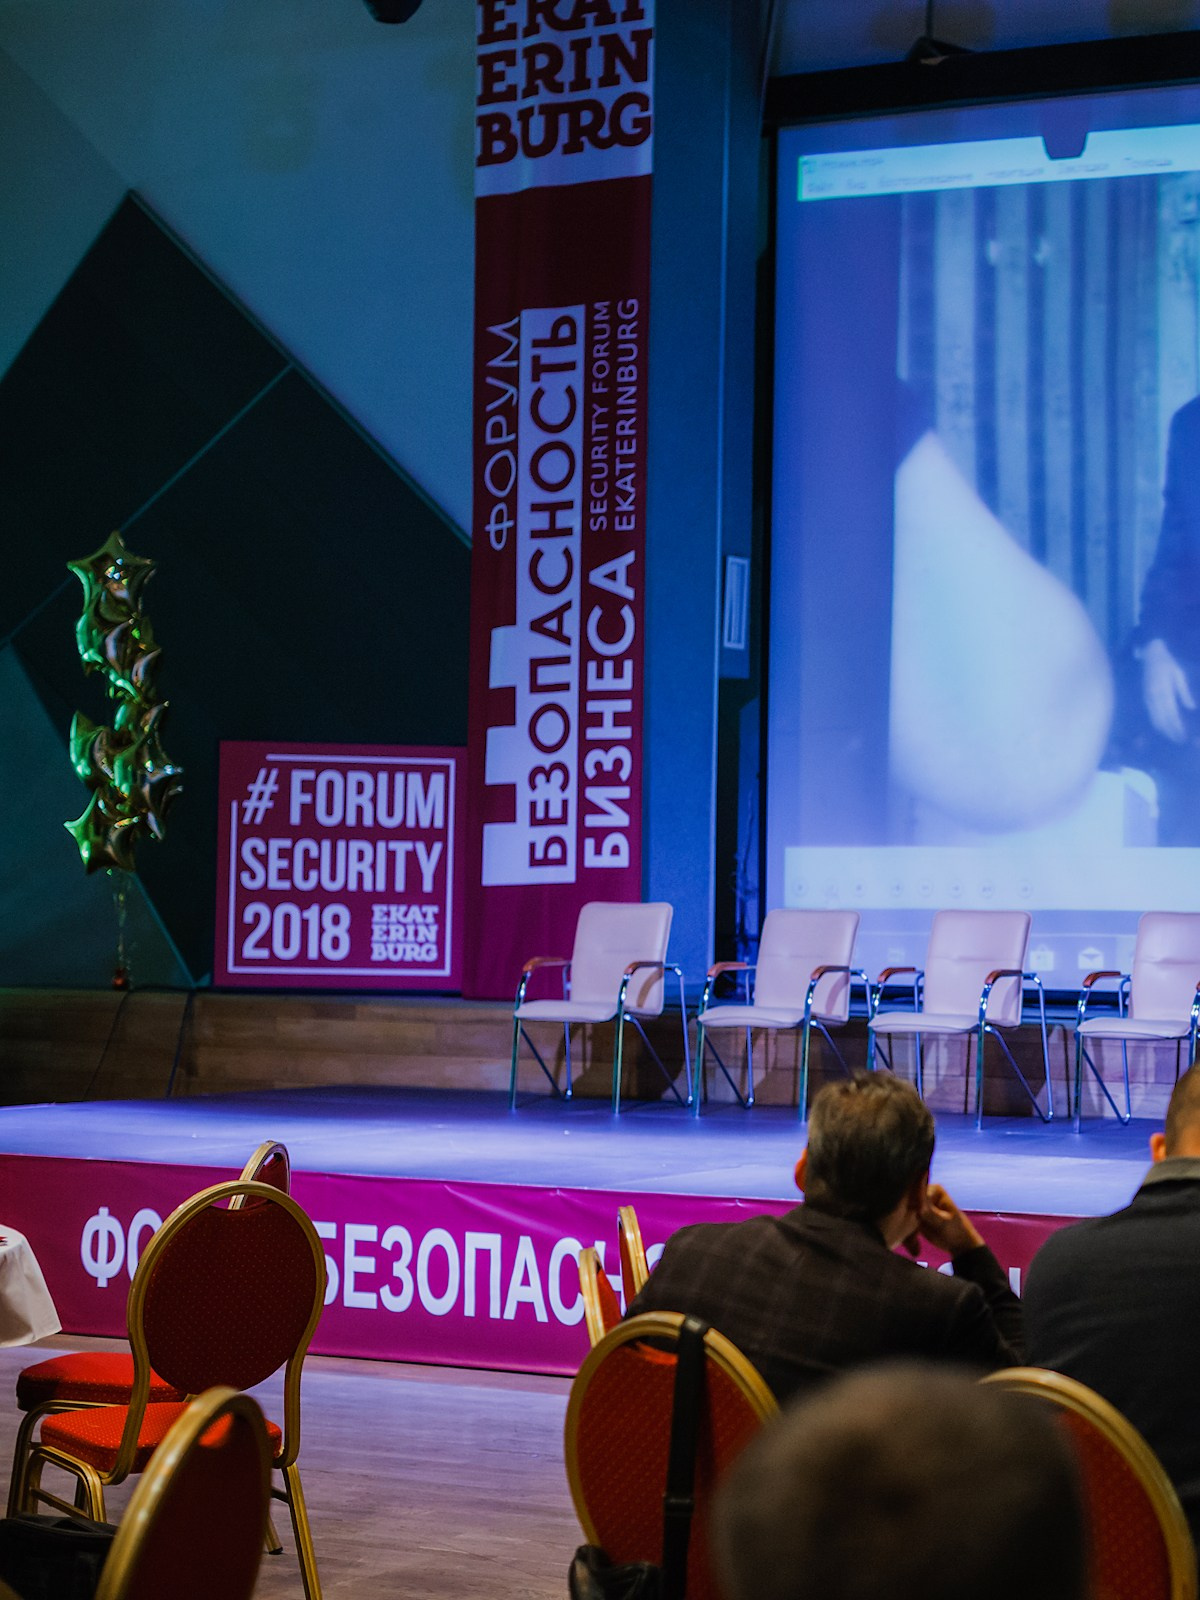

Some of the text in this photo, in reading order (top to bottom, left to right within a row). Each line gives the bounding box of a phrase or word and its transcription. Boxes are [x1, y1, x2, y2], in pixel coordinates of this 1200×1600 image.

[477, 28, 653, 107] ERIN
[476, 92, 652, 168] BURG
[484, 315, 520, 551] ФОРУМ
[589, 301, 611, 532] SECURITY FORUM
[614, 298, 639, 532] EKATERINBURG
[528, 314, 578, 869] БЕЗОПАСНОСТЬ
[583, 549, 636, 869] БИЗНЕСА
[289, 768, 445, 830] FORUM
[239, 836, 443, 894] SECURITY
[241, 901, 351, 962] 2018
[371, 904, 439, 924] EKAT
[371, 924, 438, 943] ERIN
[370, 943, 438, 962] BURG
